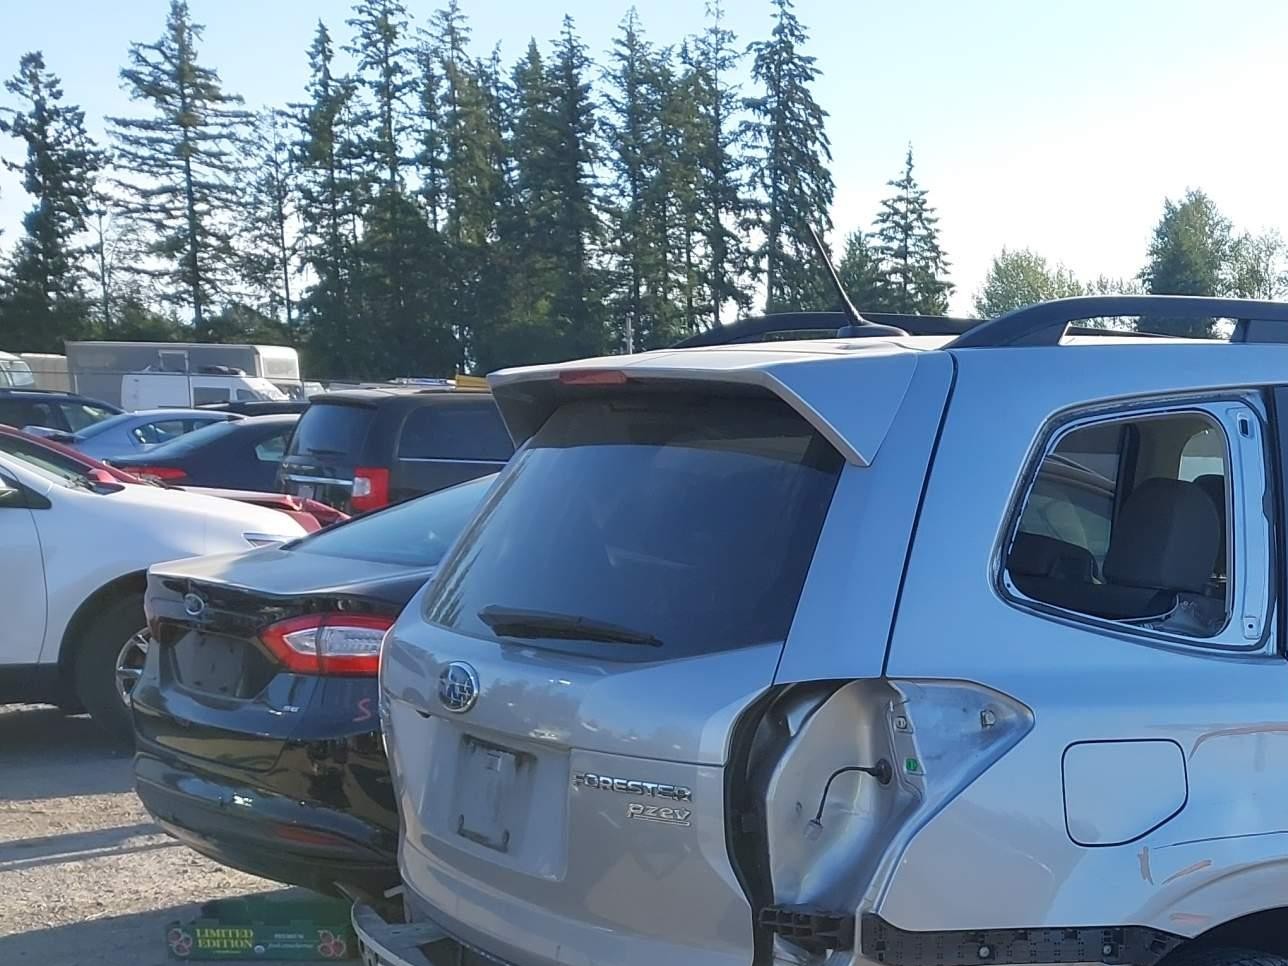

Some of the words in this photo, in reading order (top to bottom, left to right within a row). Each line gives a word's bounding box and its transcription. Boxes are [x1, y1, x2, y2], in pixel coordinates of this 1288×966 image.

[573, 773, 692, 801] FORESTER
[196, 928, 254, 938] LIMITED
[198, 938, 253, 949] EDITION
